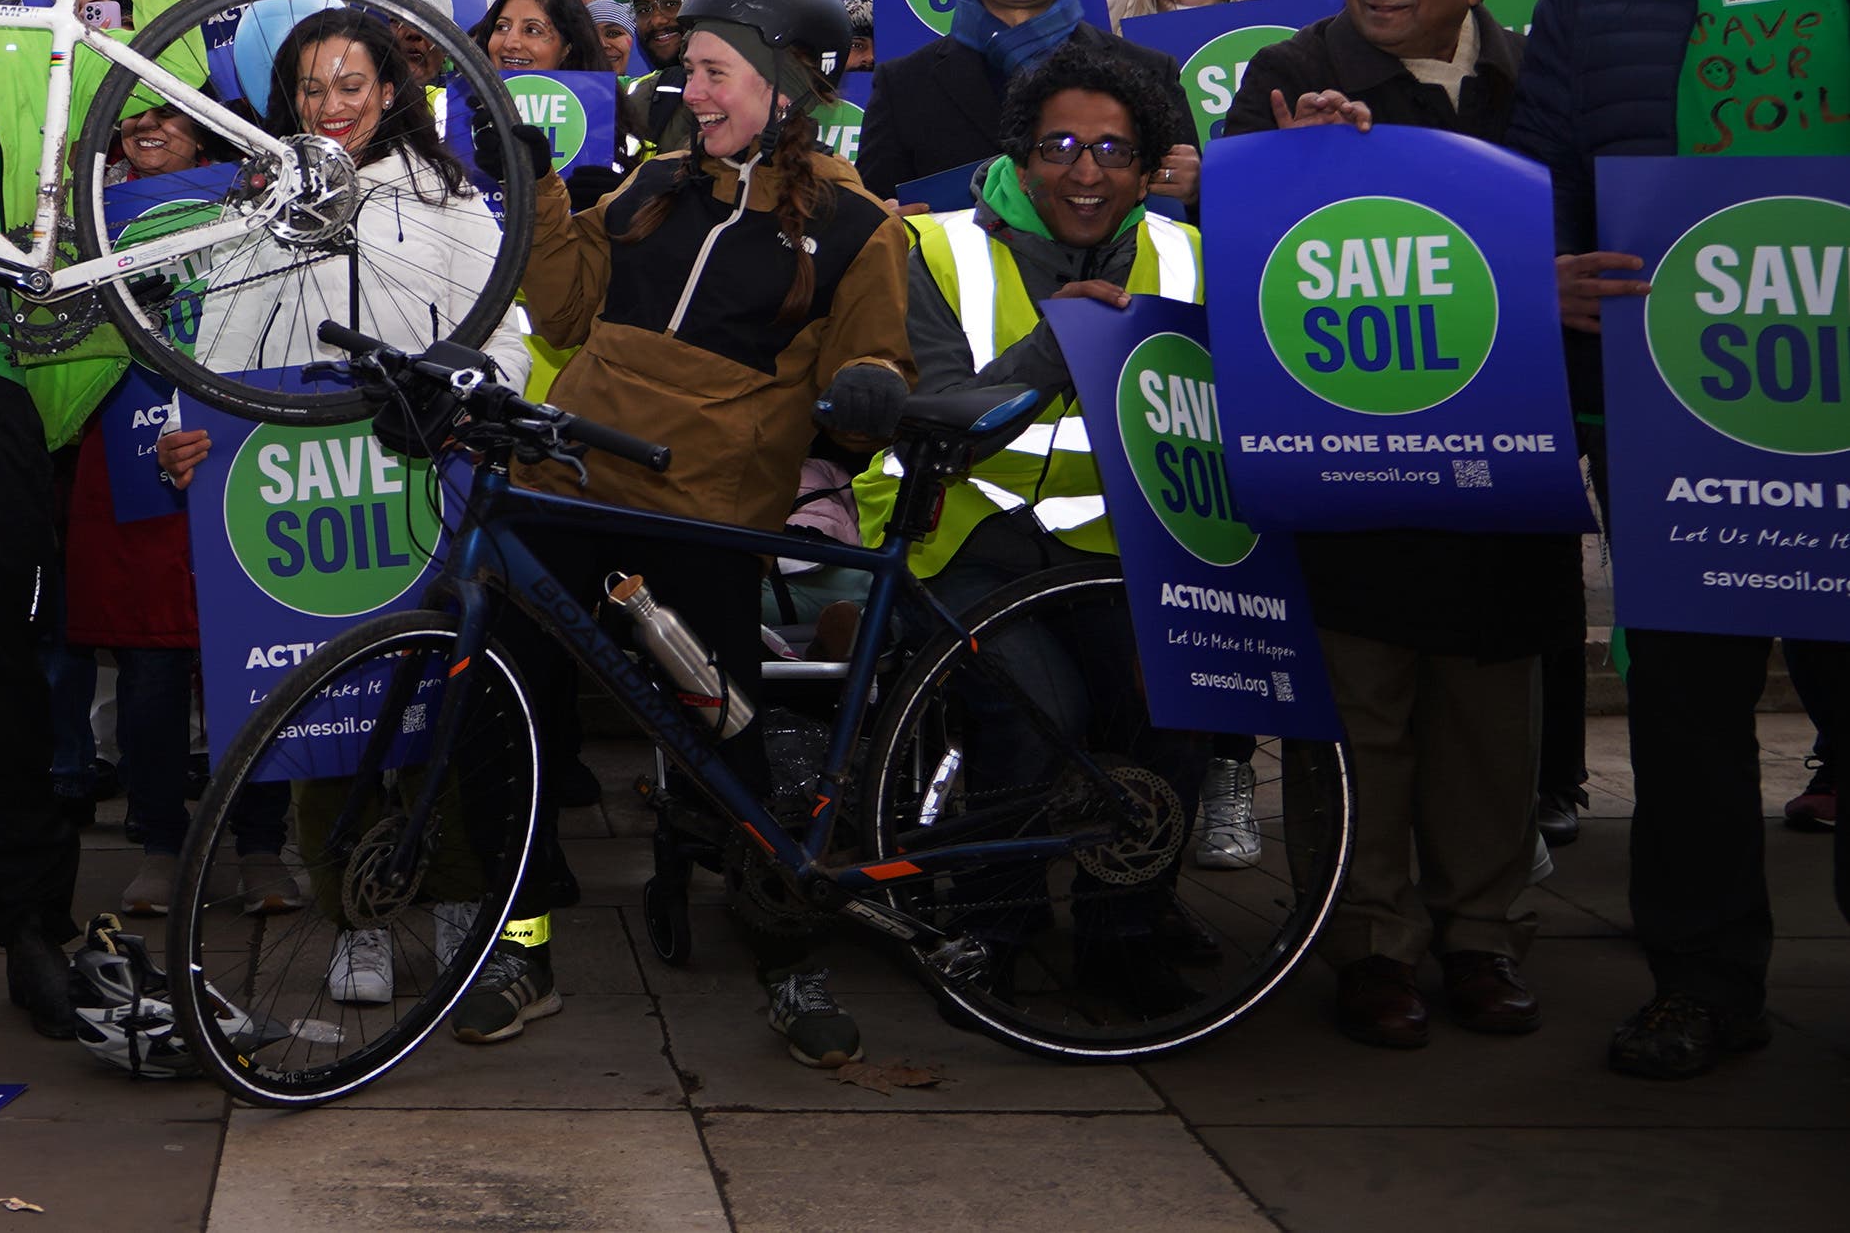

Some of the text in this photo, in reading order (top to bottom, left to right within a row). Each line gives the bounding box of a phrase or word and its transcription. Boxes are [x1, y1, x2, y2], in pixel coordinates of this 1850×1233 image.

[514, 94, 567, 124] AVE
[1296, 235, 1454, 300] SAVE
[1694, 244, 1850, 316] SAV
[1303, 304, 1460, 374] SOIL
[1699, 322, 1850, 404] SOI
[1139, 369, 1223, 444] SAV
[1240, 433, 1556, 454] EACH ONE REACH ONE
[1321, 468, 1440, 485] savesoil.org
[1666, 477, 1824, 508] ACTION
[265, 502, 411, 578] SOIL
[1669, 525, 1710, 543] Let
[1719, 526, 1749, 546] Us
[1756, 531, 1821, 549] Make
[1161, 582, 1287, 622] ACTION NOW
[246, 642, 330, 669] ACTI
[1168, 628, 1297, 659] Let Us Make It Happen
[367, 680, 383, 696] It
[1190, 670, 1269, 698] savesoil.org
[503, 929, 533, 938] WIN
